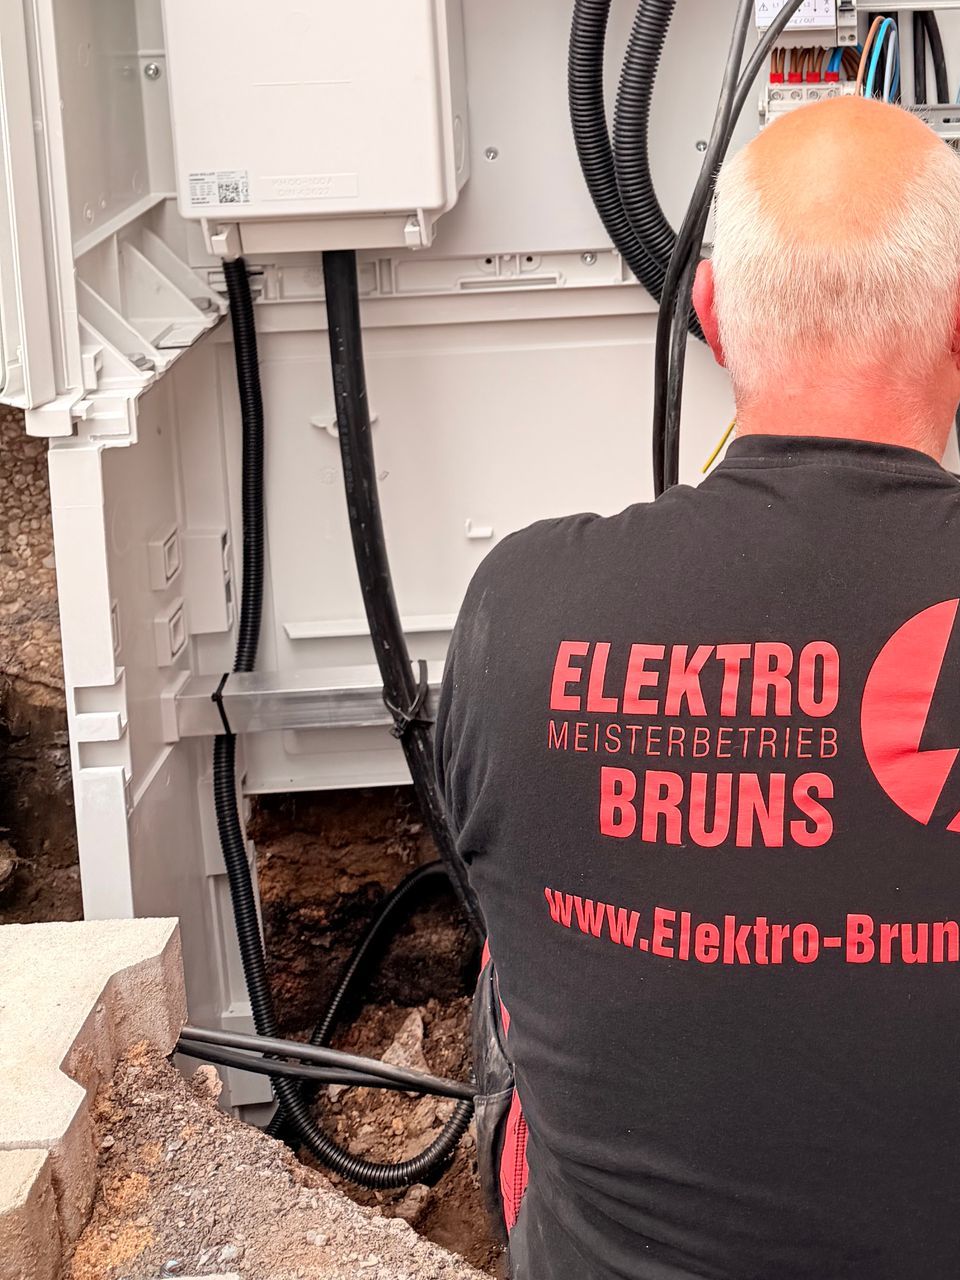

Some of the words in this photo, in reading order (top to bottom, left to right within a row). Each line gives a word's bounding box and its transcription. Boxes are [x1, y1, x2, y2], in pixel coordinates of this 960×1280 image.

[549, 640, 839, 719] ELEKTRO
[547, 720, 838, 759] MEISTERBETRIEB
[600, 766, 834, 848] BRUNS
